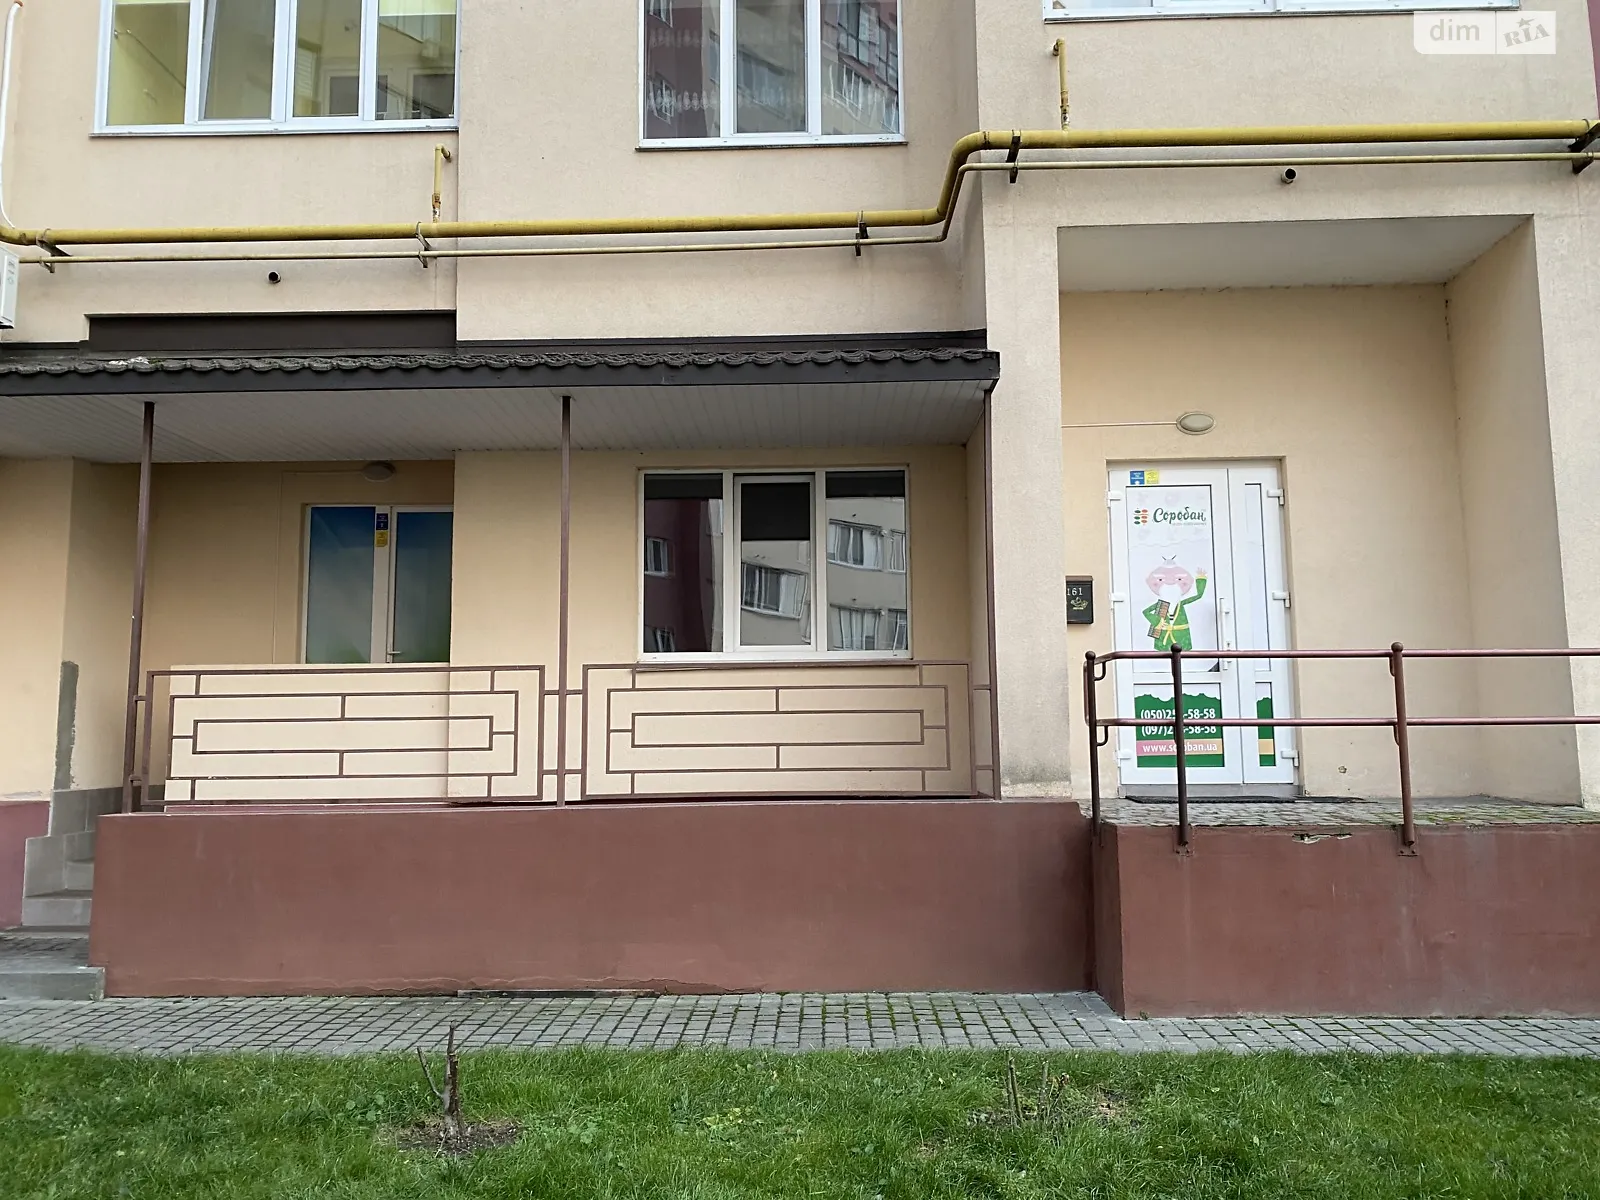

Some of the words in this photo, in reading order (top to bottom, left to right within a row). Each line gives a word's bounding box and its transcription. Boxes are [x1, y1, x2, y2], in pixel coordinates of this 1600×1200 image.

[1153, 506, 1206, 524] Соробан
[1066, 587, 1083, 596] 161
[1140, 708, 1216, 719] (050)25-58-58
[1141, 726, 1217, 737] (097)2-58-58
[1142, 742, 1218, 753] www.soban.ua
